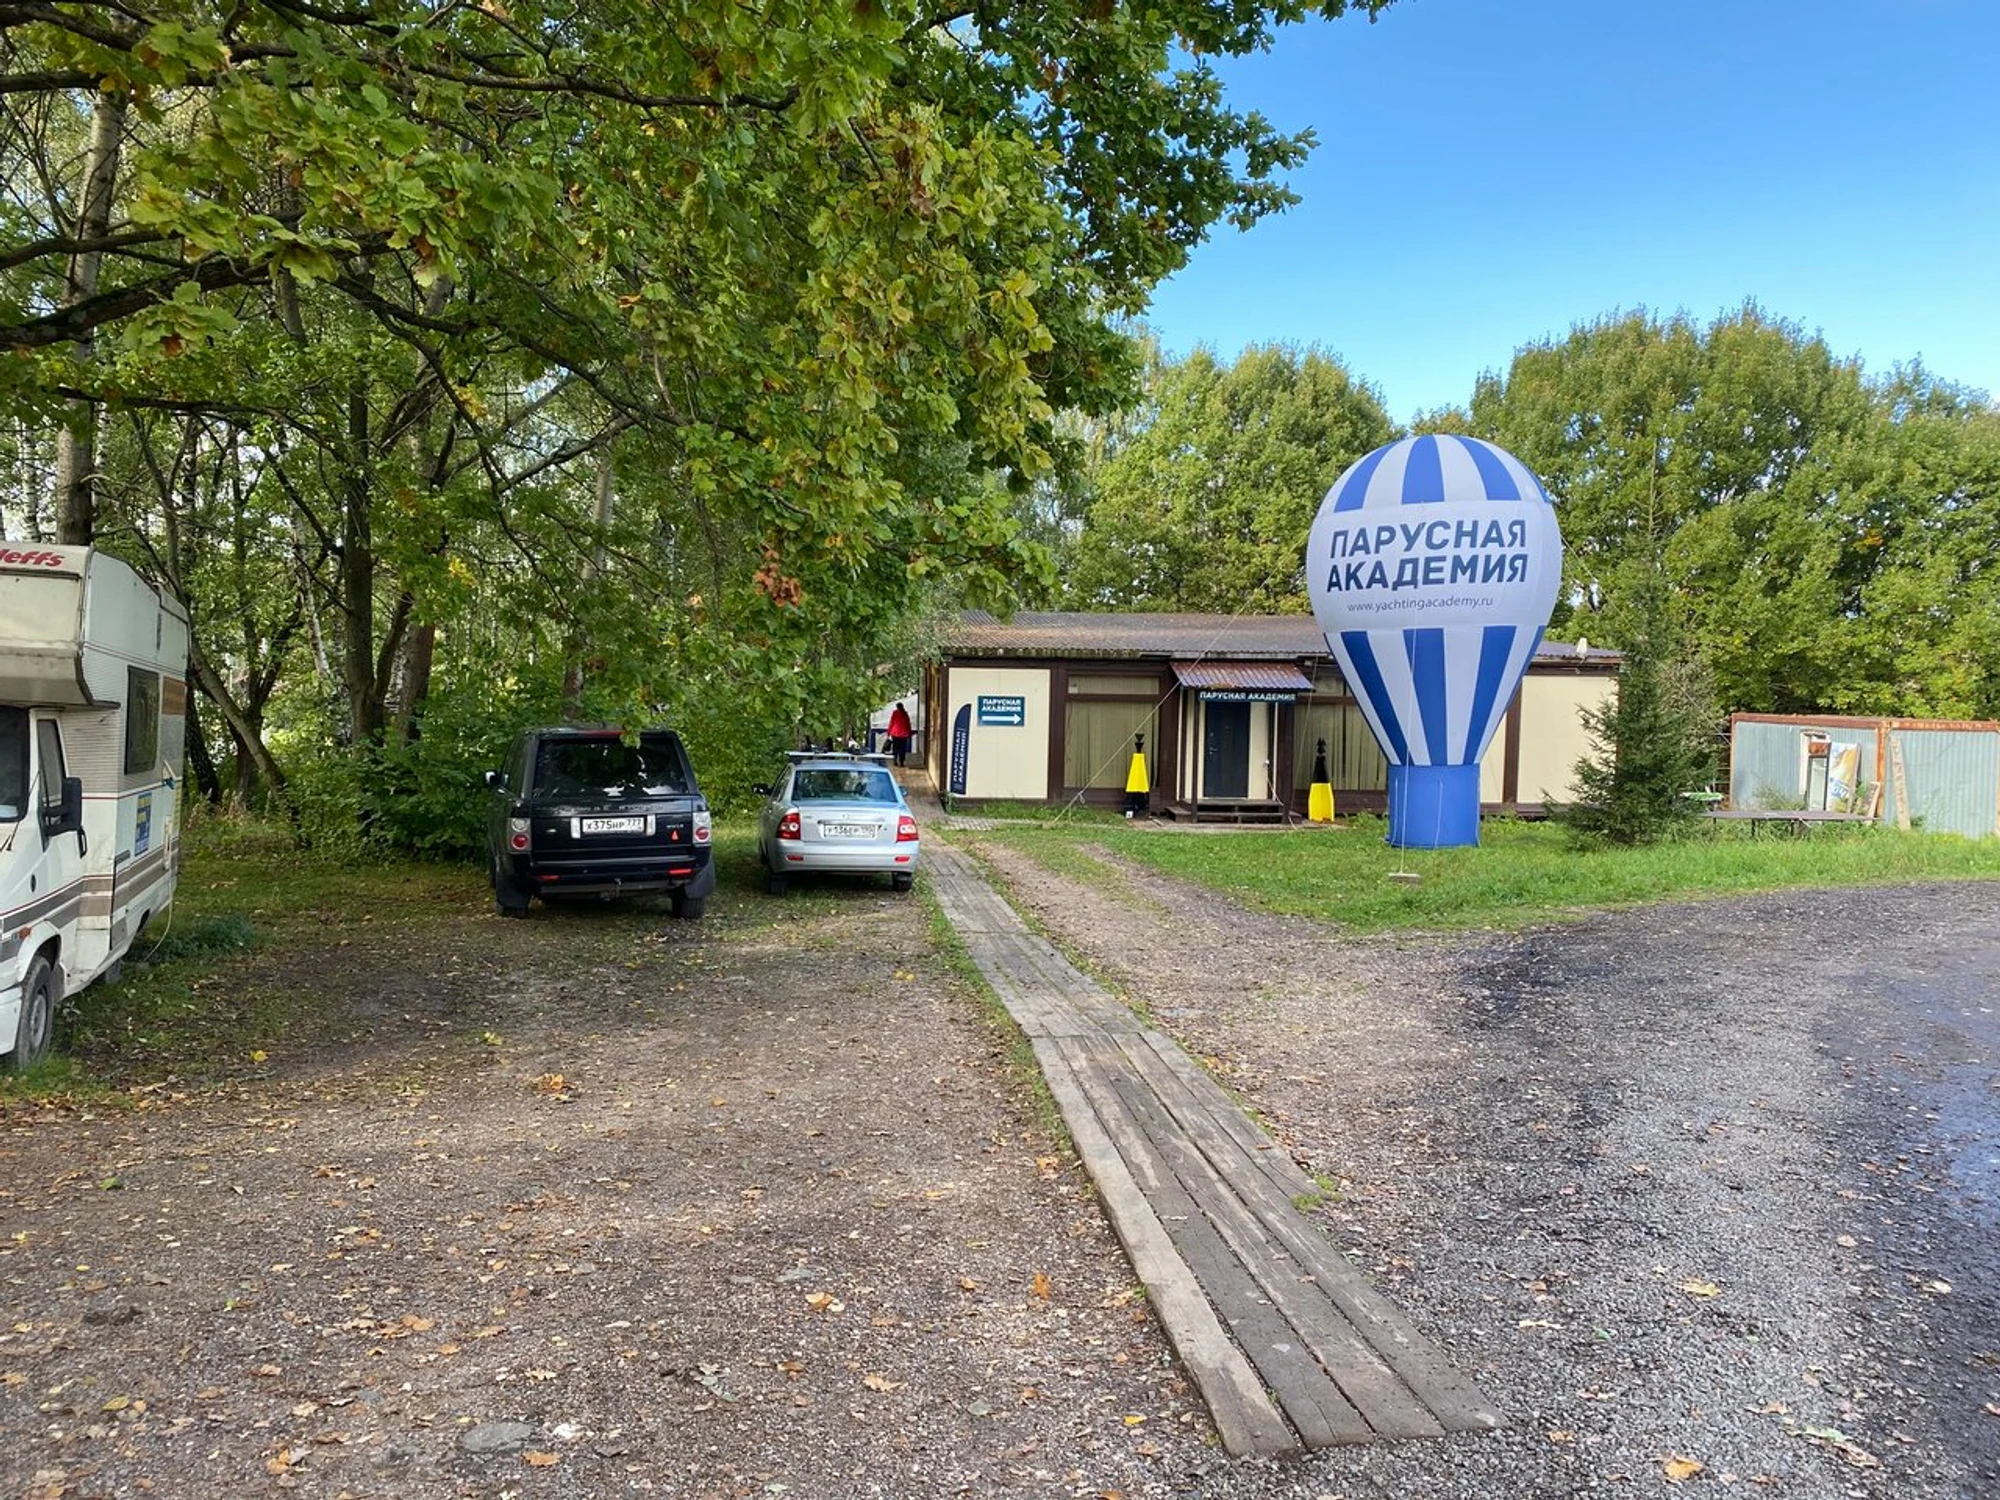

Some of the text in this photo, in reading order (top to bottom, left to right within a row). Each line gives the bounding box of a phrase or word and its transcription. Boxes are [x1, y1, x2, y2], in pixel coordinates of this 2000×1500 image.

[1330, 519, 1526, 559] ПАРУСНАЯ
[1327, 553, 1528, 593] АКАДЕМИЯ
[1347, 596, 1494, 613] www.yachtingacademy.ru
[982, 698, 1021, 706] ПАРУСНАЯ
[1200, 690, 1296, 701] ПАРУСНАЯ АКАДЕМИЯ
